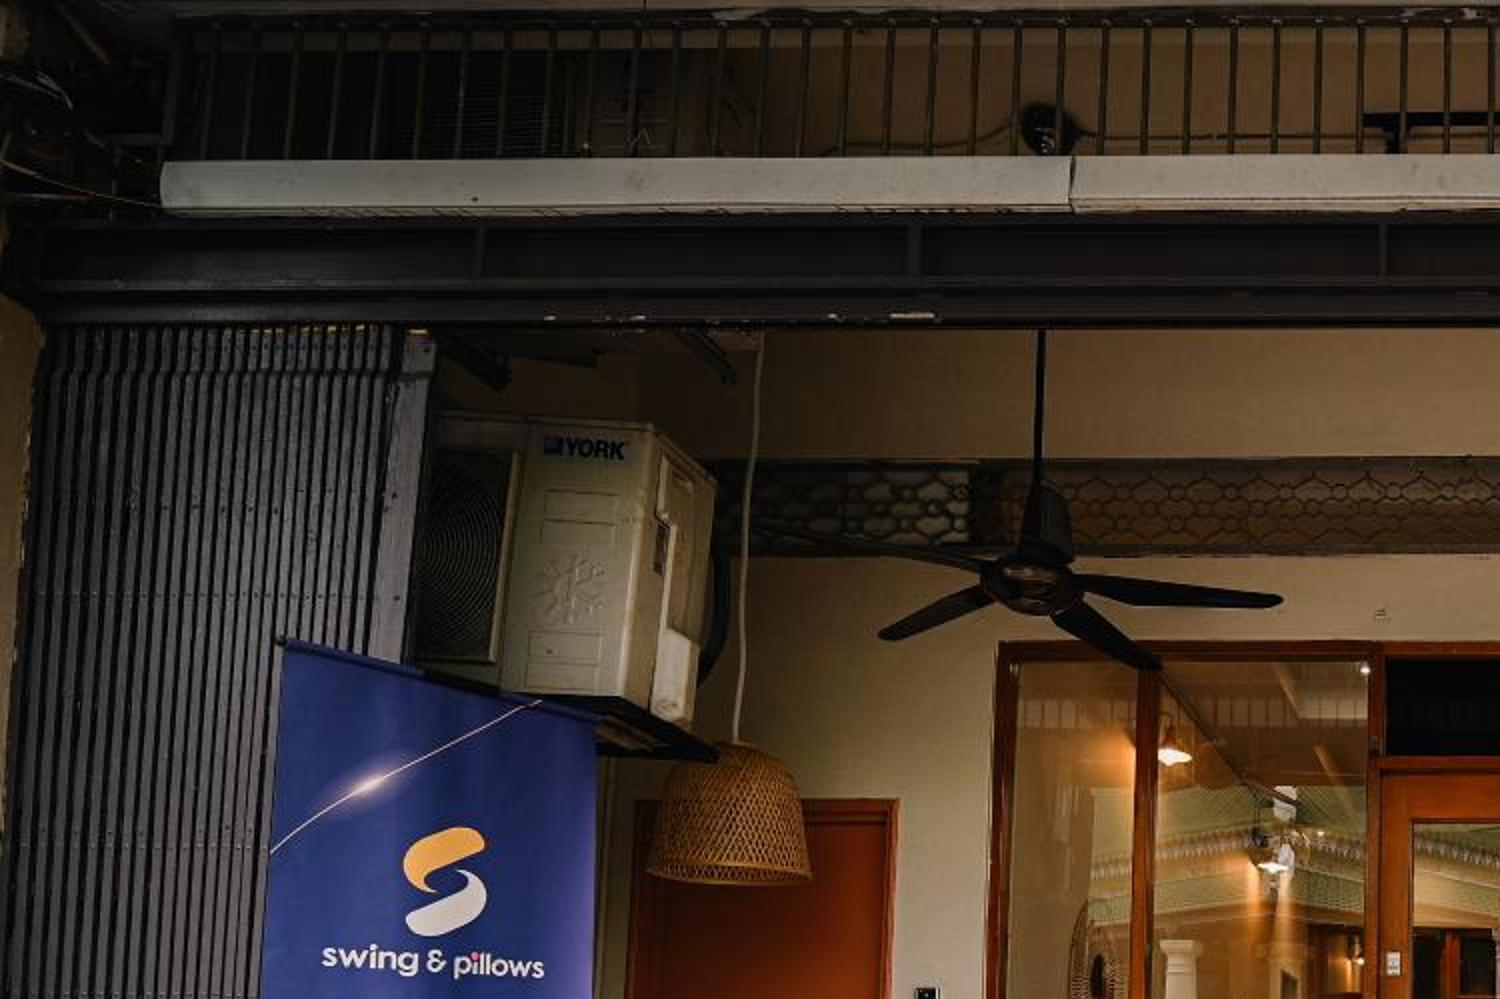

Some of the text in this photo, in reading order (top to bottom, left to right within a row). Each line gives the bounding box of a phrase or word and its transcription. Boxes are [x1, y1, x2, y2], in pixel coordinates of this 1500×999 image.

[565, 437, 625, 460] YORK
[321, 943, 545, 980] swing & pillows
